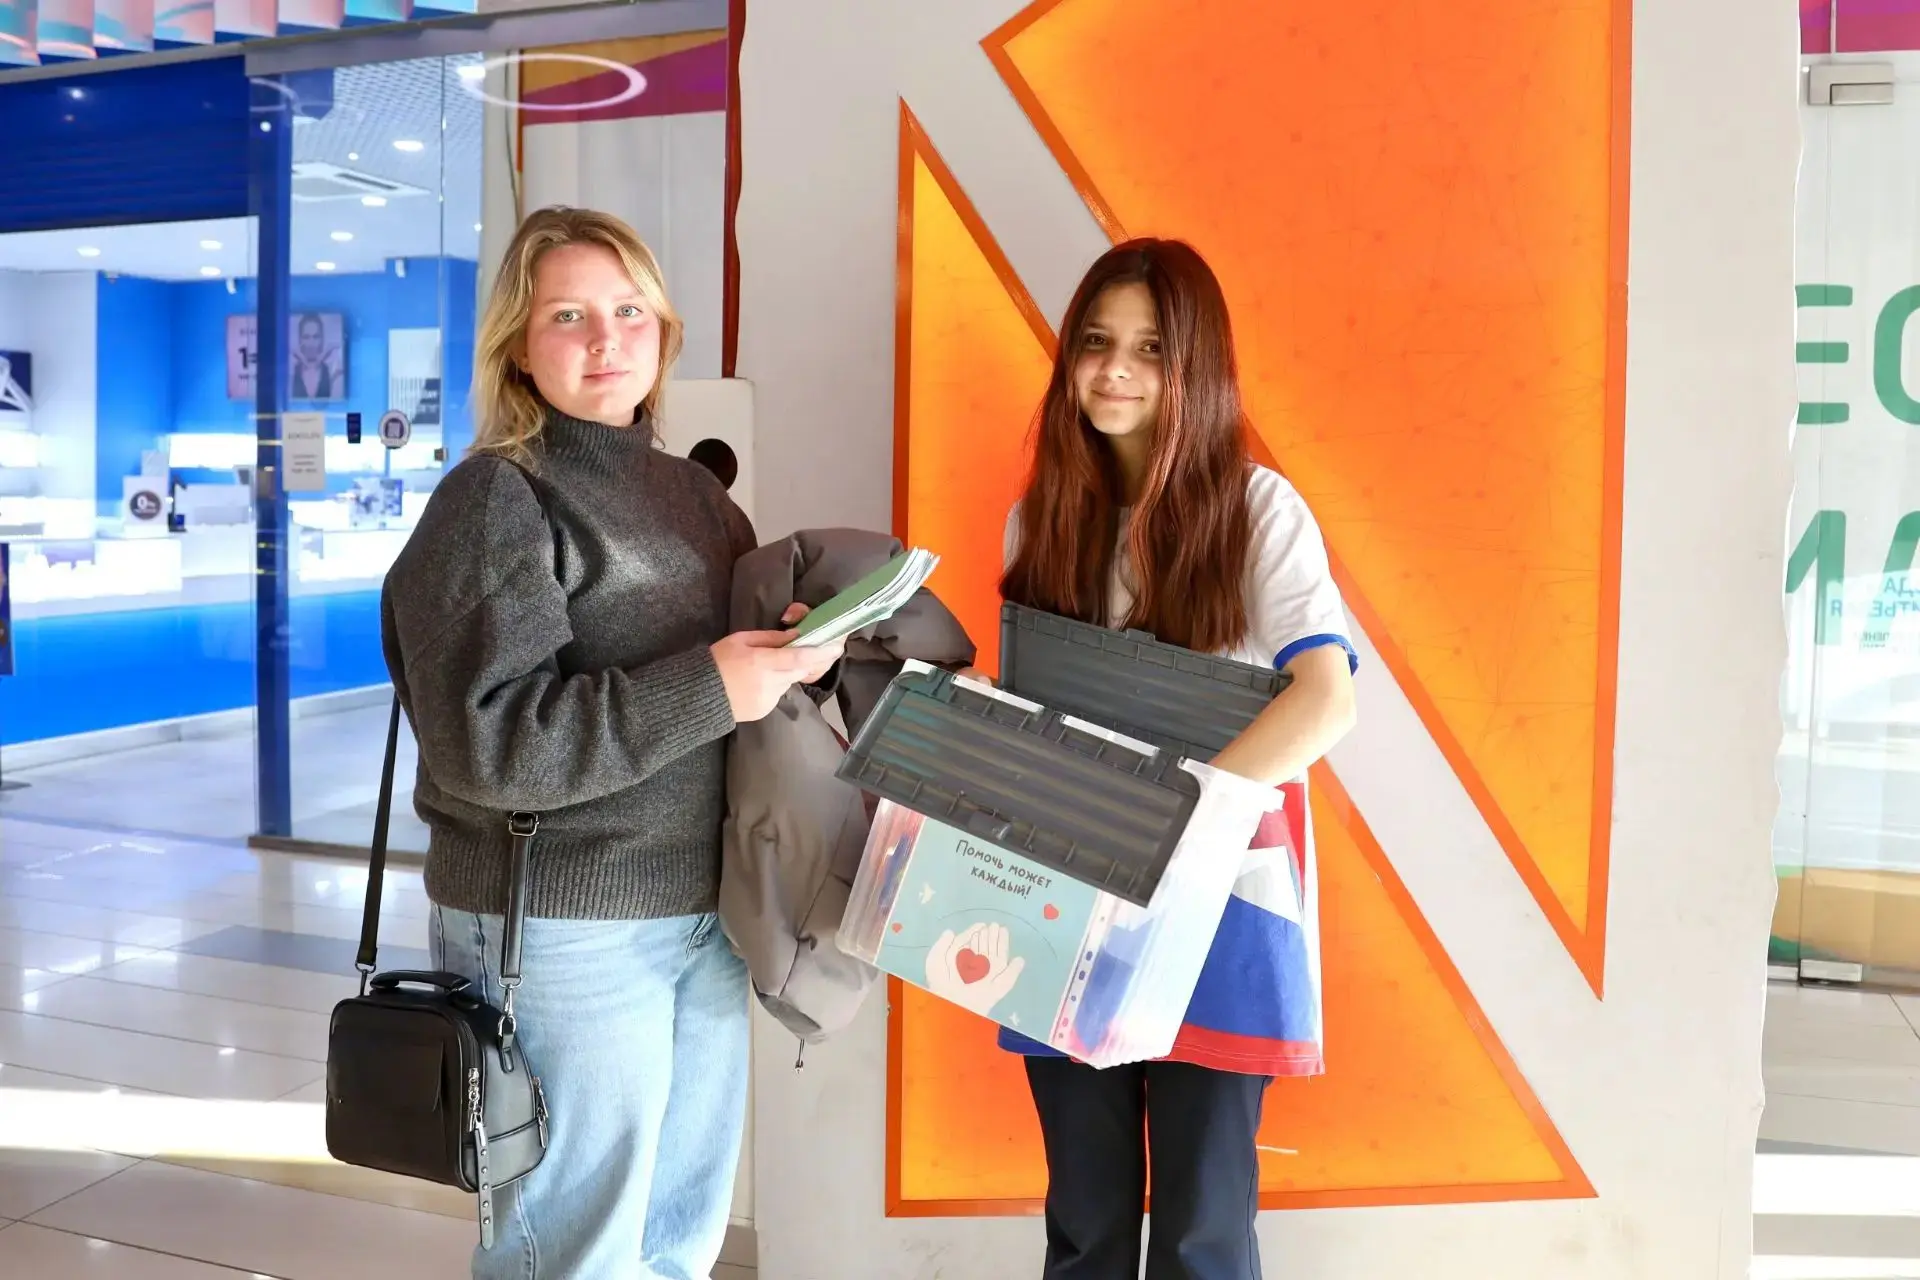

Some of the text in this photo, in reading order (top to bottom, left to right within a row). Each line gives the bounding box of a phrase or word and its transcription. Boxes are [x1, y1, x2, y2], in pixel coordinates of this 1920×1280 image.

[956, 839, 1052, 889] Помочь может
[970, 865, 1032, 900] каждый!
